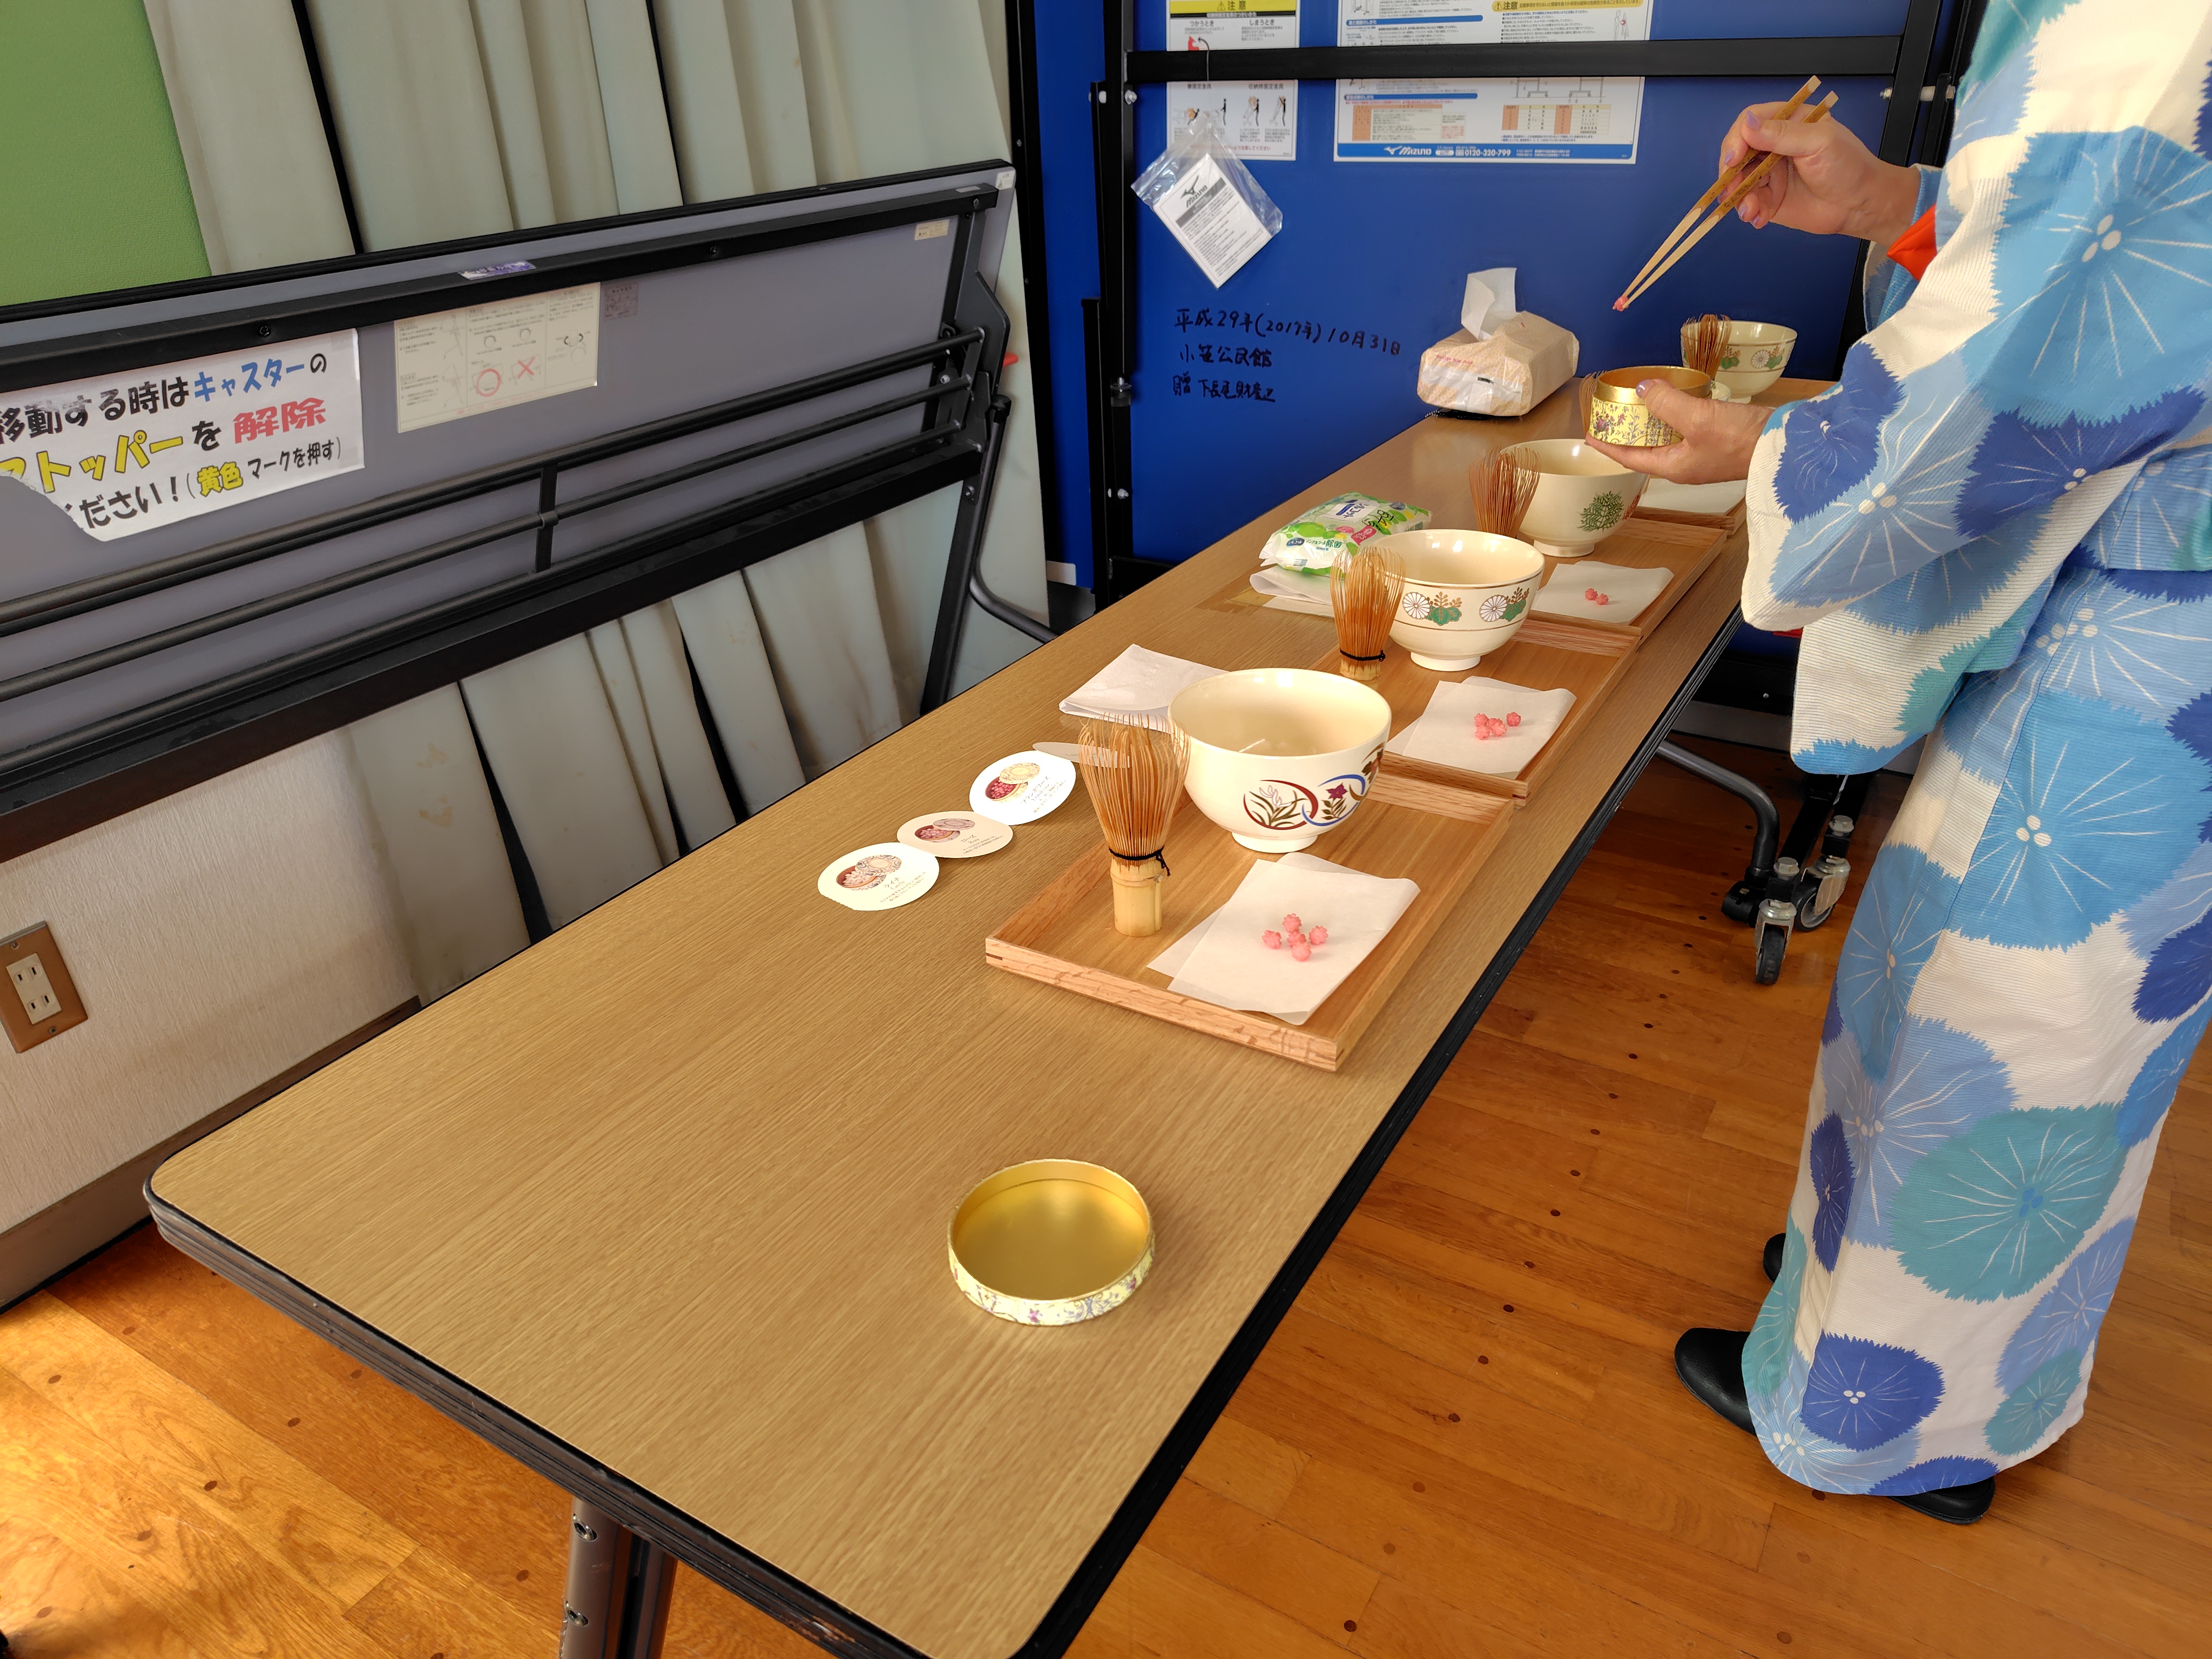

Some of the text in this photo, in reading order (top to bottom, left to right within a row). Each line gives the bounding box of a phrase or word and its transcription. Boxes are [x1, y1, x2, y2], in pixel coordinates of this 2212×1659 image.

[1227, 1, 1247, 10] 注意
[1503, 2, 1518, 10] 注意
[1465, 149, 1511, 157] 0120-320-799
[884, 876, 900, 888] ライチ
